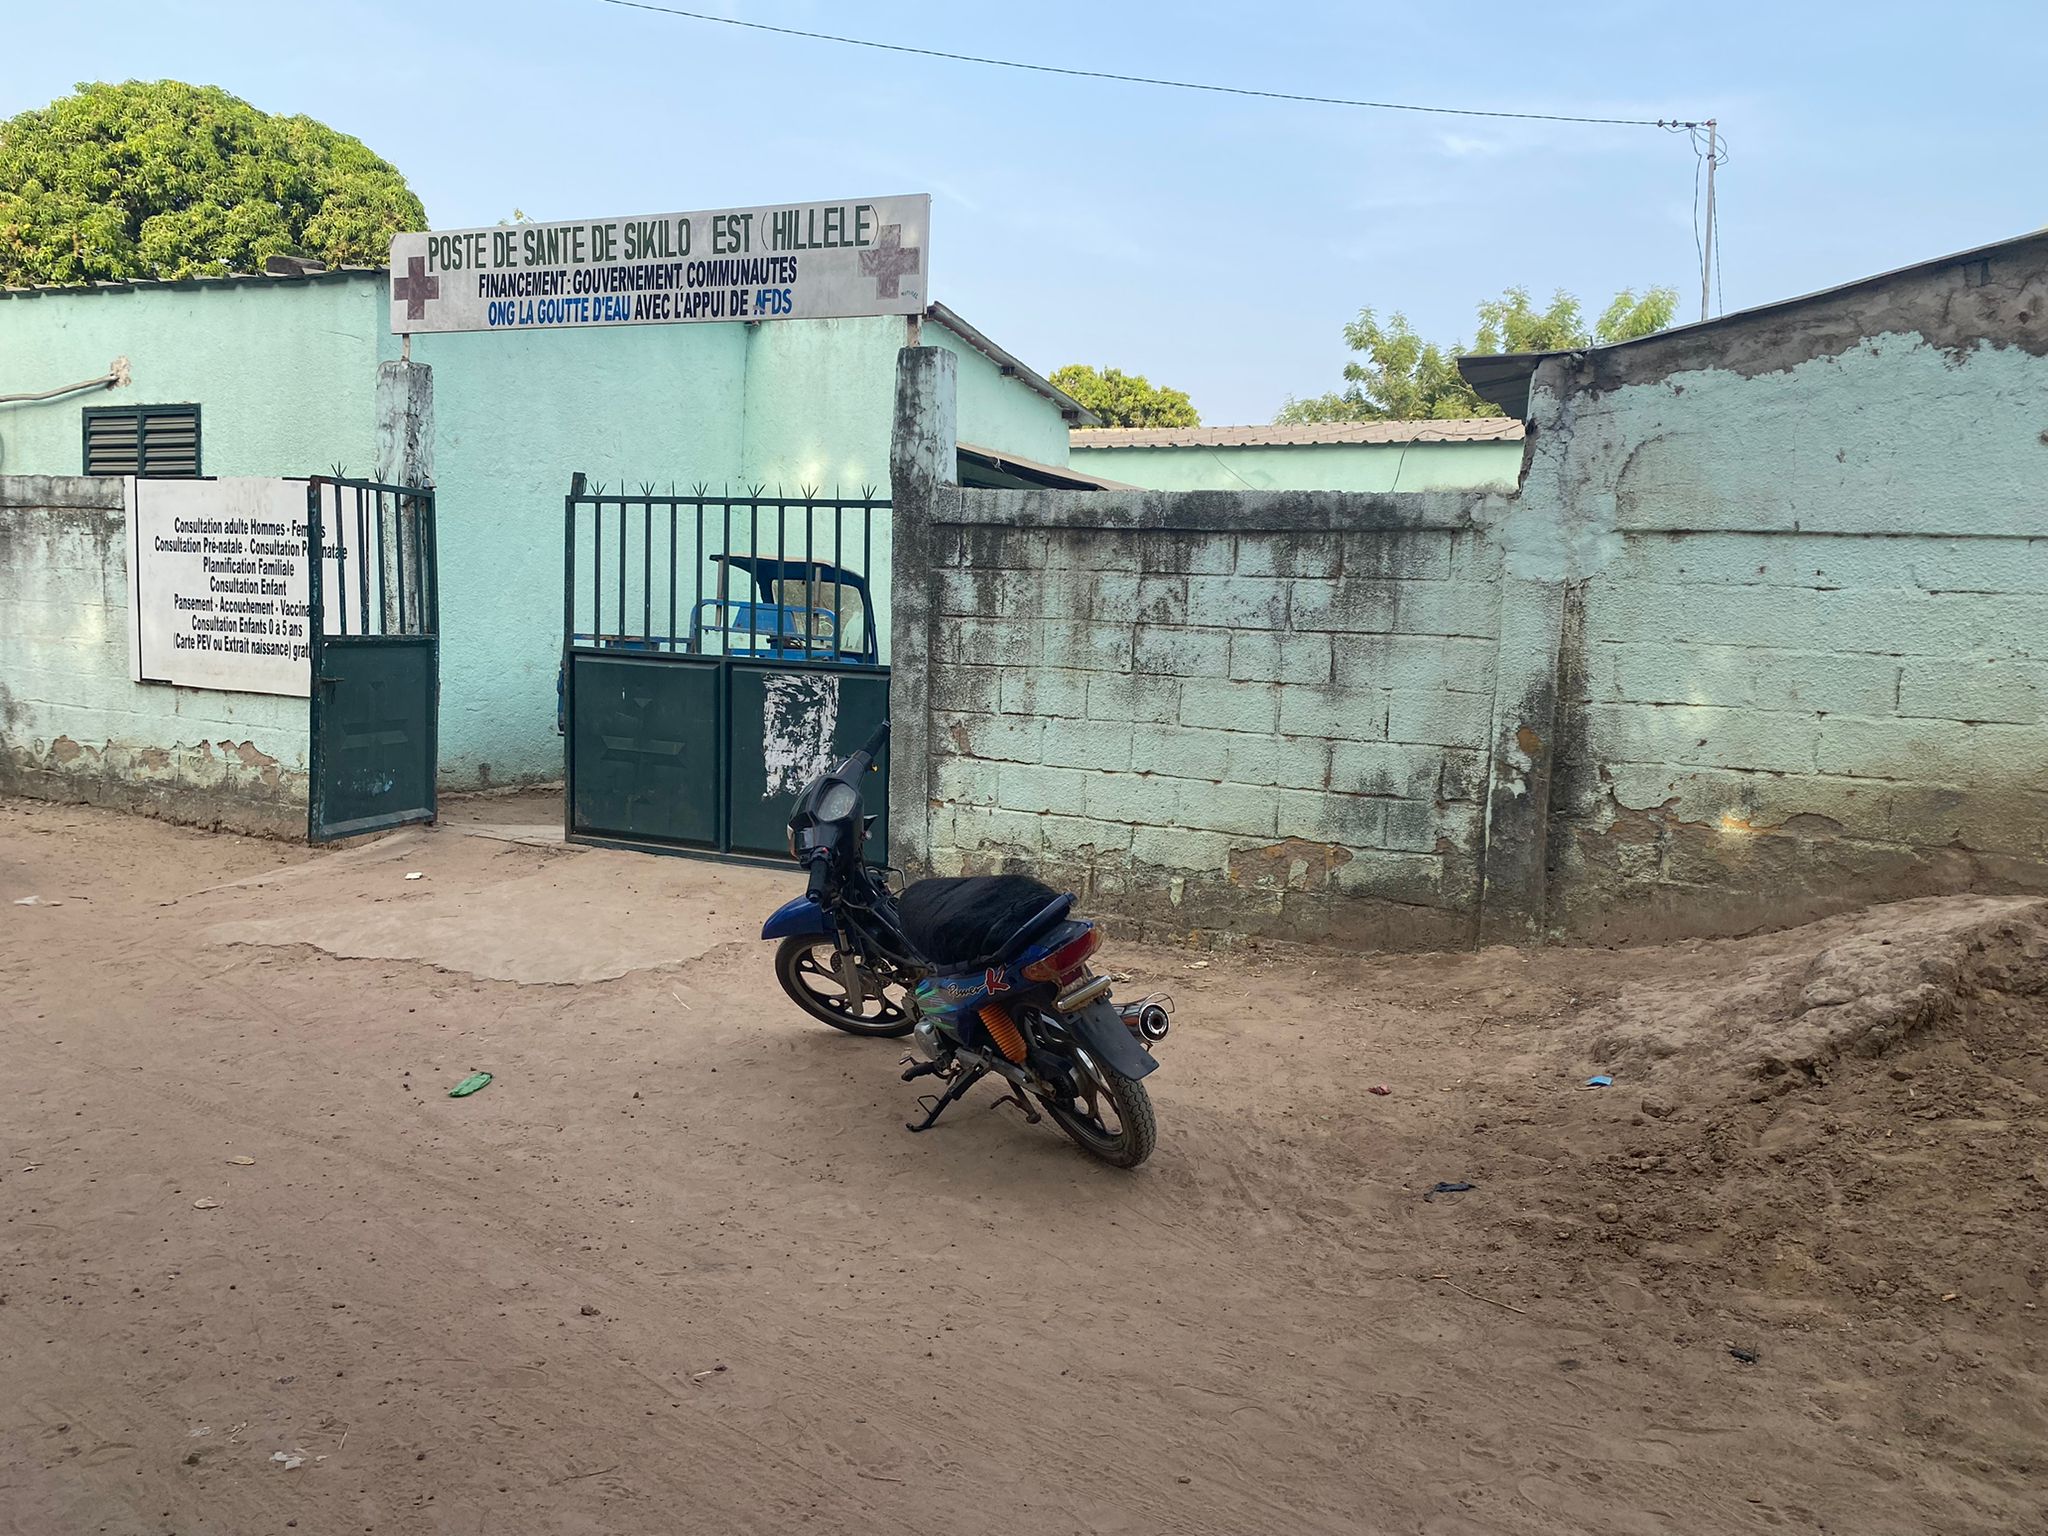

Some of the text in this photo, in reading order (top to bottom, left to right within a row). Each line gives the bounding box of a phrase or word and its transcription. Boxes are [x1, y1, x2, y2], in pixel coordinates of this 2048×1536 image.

[428, 205, 879, 272] POSTE DE SANTE DE SIKILO EST (HILLELE)
[687, 255, 797, 287] COMMUNAUTES
[488, 288, 792, 326] ONG LA GOUTTE D'EAU AVEC L'APPUI DE AFDS
[174, 517, 223, 534] Consultation
[224, 518, 249, 535] adulte
[250, 518, 285, 536] Hommes
[291, 519, 326, 538] Fems
[154, 536, 202, 553] Consultation
[203, 537, 243, 554] Pré-natale
[250, 538, 300, 557] Consultation
[203, 557, 295, 577] Plannification Familiale
[210, 576, 287, 596] Consultation Enfant
[174, 593, 214, 612] Pansement
[219, 596, 274, 615] Accouchement
[280, 599, 324, 618] Vaccina
[191, 614, 303, 637] Consultation Enfants 0 à 5 ans
[173, 632, 311, 662] (Carte PEV ou Extrait naissance) grat
[984, 966, 1011, 996] K
